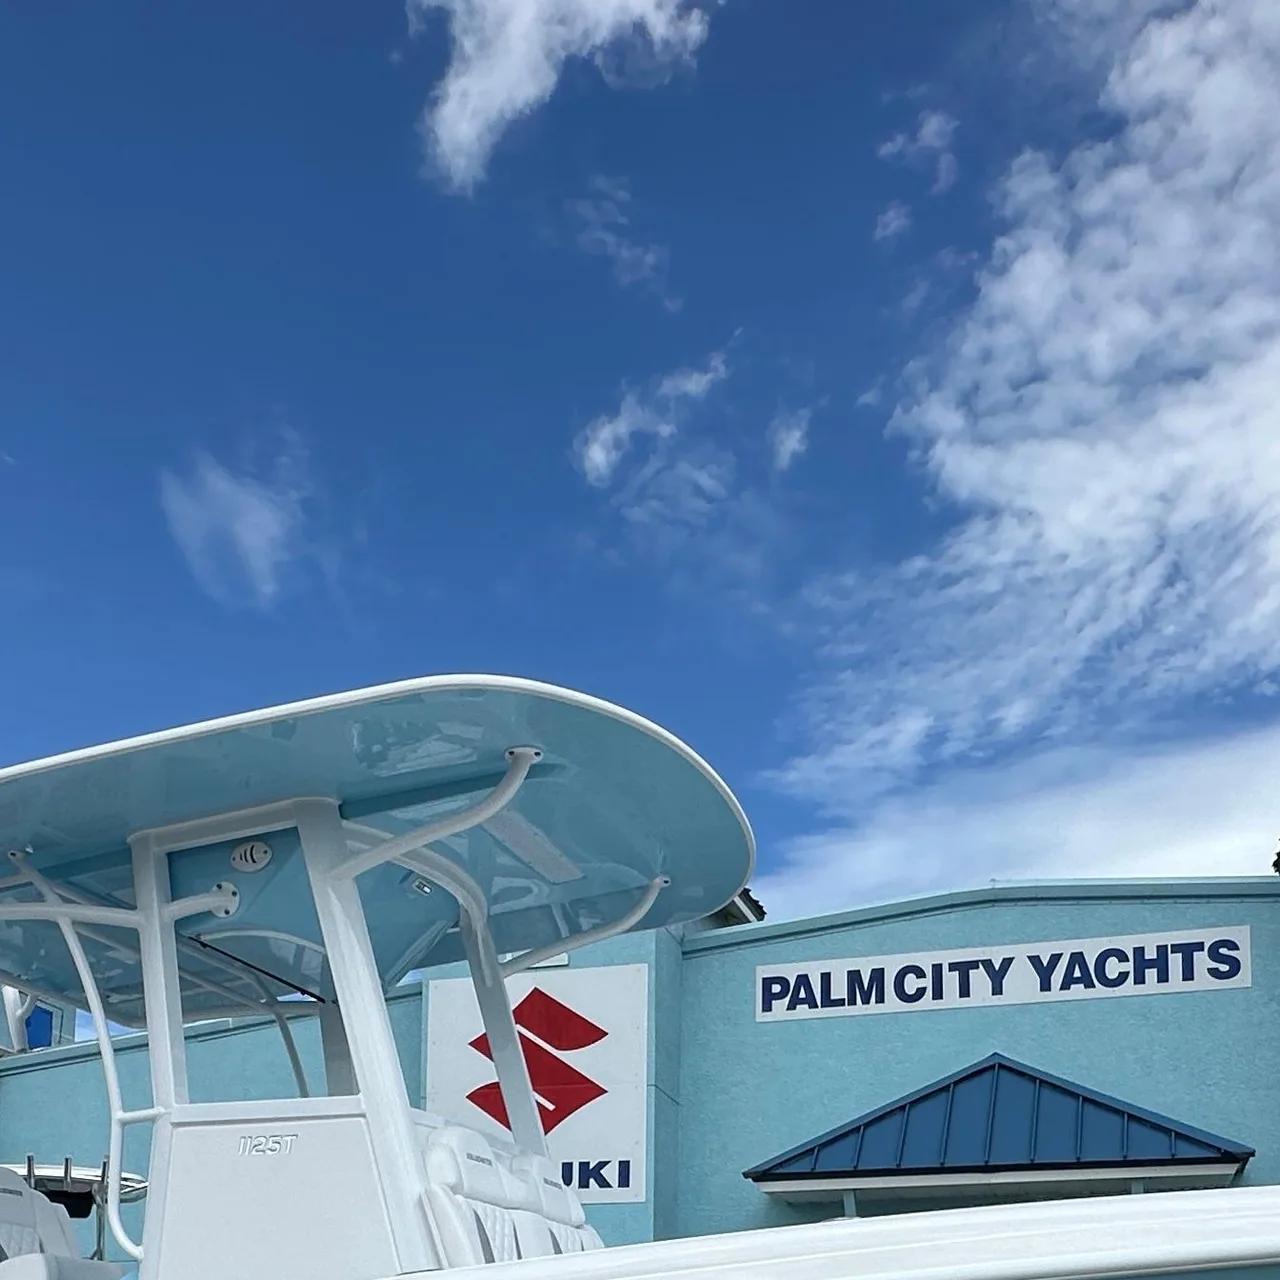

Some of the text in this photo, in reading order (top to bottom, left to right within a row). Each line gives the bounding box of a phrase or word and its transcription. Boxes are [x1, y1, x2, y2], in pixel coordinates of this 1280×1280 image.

[761, 938, 1242, 1013] PALM CITY YACHTS
